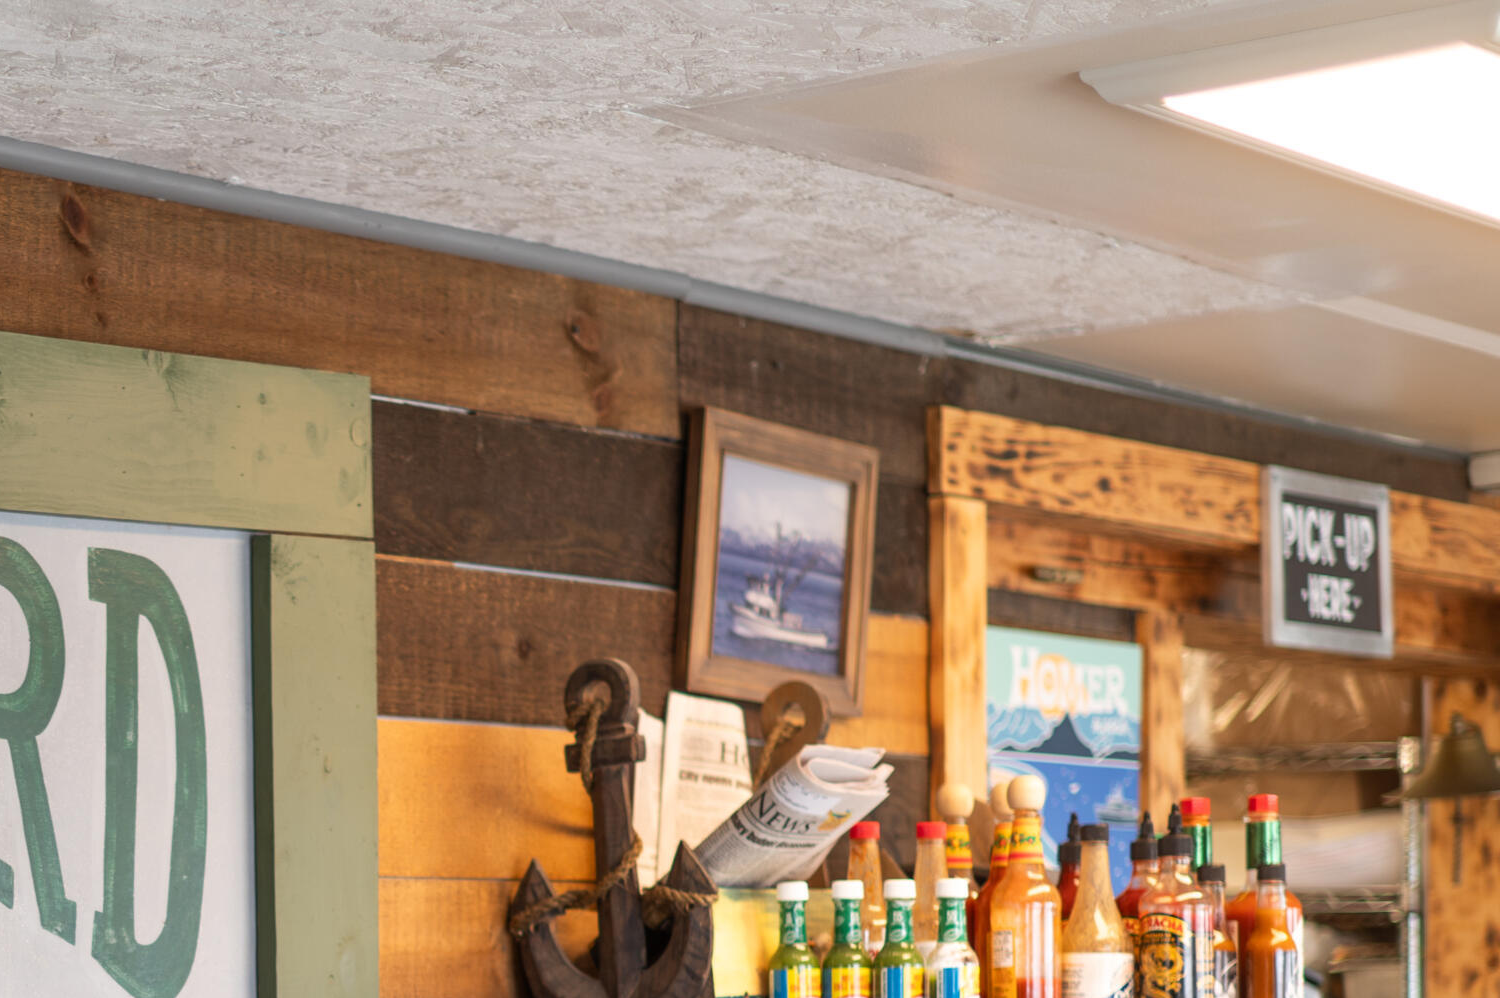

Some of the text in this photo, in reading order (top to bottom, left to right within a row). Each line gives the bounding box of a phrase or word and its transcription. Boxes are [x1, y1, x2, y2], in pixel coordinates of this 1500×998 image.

[1281, 501, 1376, 573] PICK-UP
[1009, 644, 1130, 717] HOMER
[1147, 916, 1184, 934] RACHA
